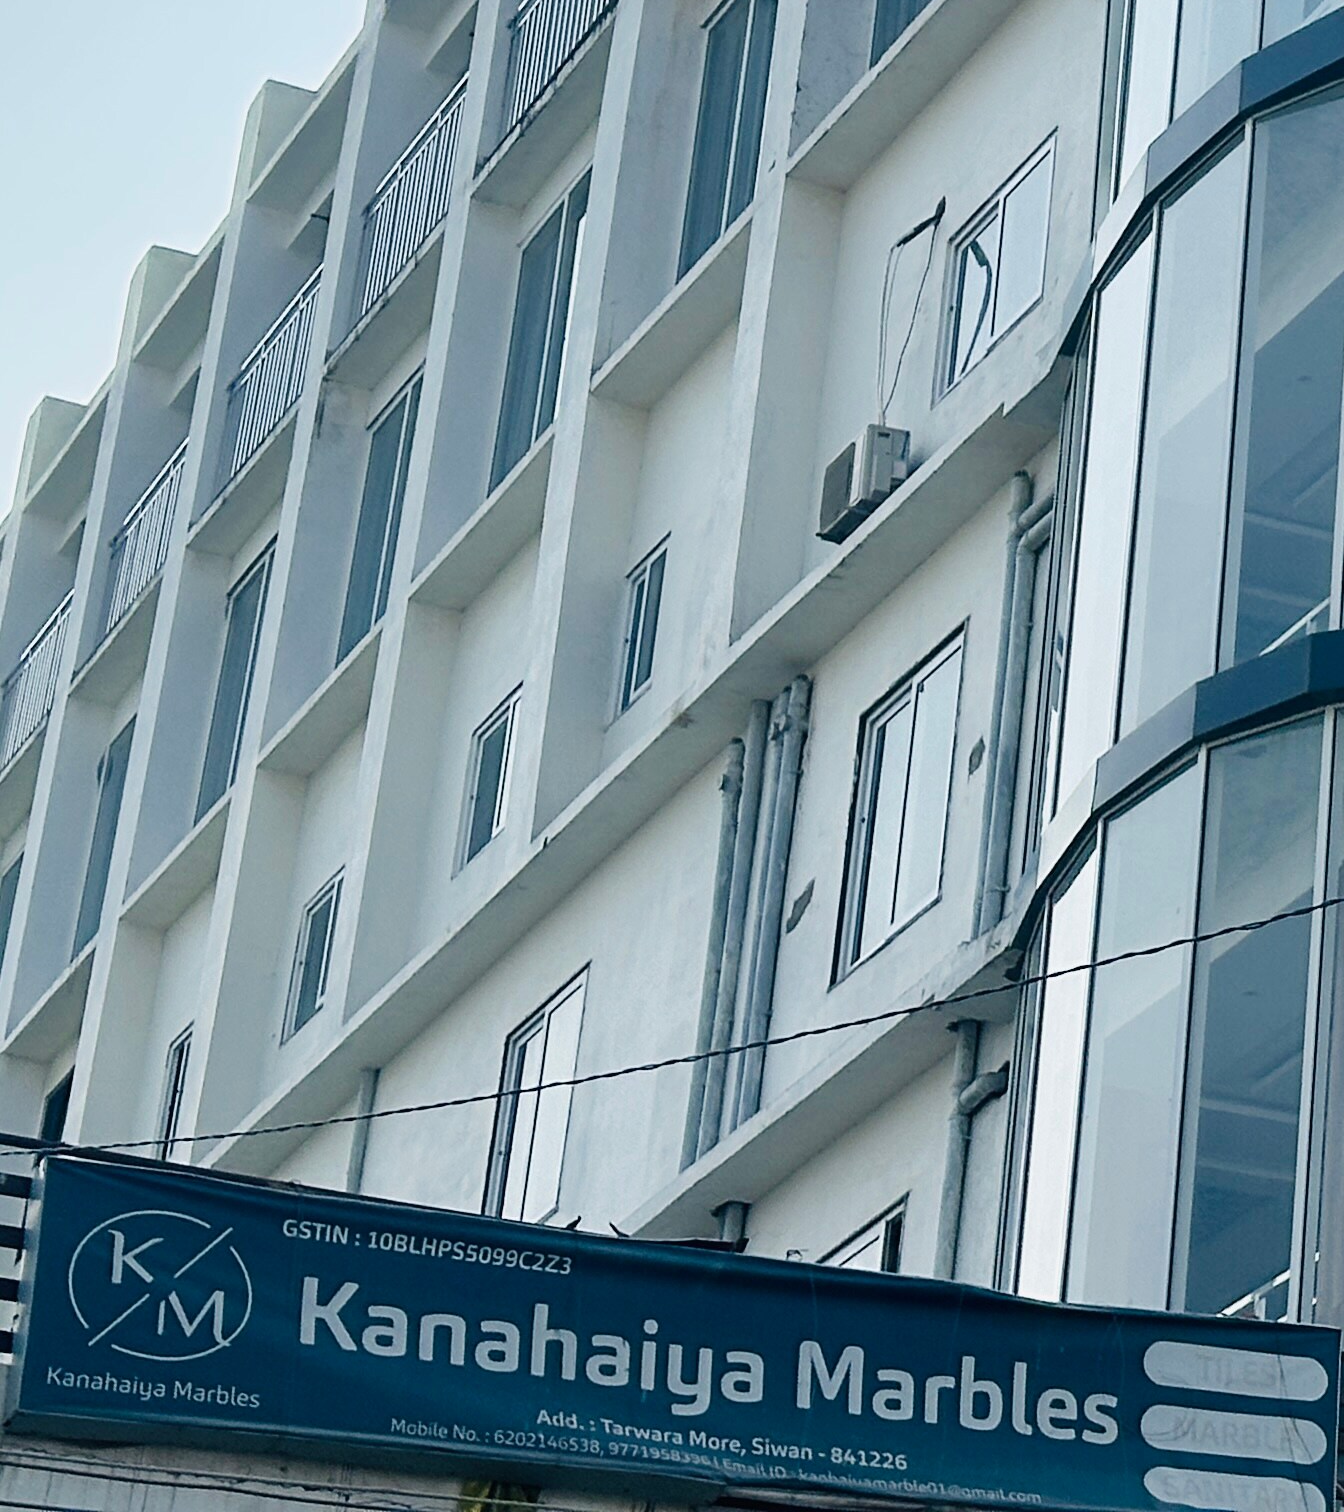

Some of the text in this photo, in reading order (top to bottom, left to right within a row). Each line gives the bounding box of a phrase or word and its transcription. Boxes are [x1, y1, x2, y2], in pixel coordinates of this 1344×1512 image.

[107, 1229, 164, 1285] K
[282, 1219, 349, 1245] GSTIN
[367, 1230, 573, 1275] 10BLHPS5099C2Z3
[157, 1289, 231, 1347] M
[46, 1367, 261, 1408] Kanahaiya Marbles
[299, 1276, 1120, 1445] Kanahaiya Marbles
[1196, 1354, 1277, 1390] TILES
[390, 1418, 448, 1439] Mobile
[453, 1424, 482, 1442] No.
[536, 1409, 585, 1431] Add.
[600, 1418, 683, 1445] Tarwara
[689, 1431, 746, 1456] More,
[752, 1437, 813, 1461] Siwan
[831, 1447, 908, 1471] 841226
